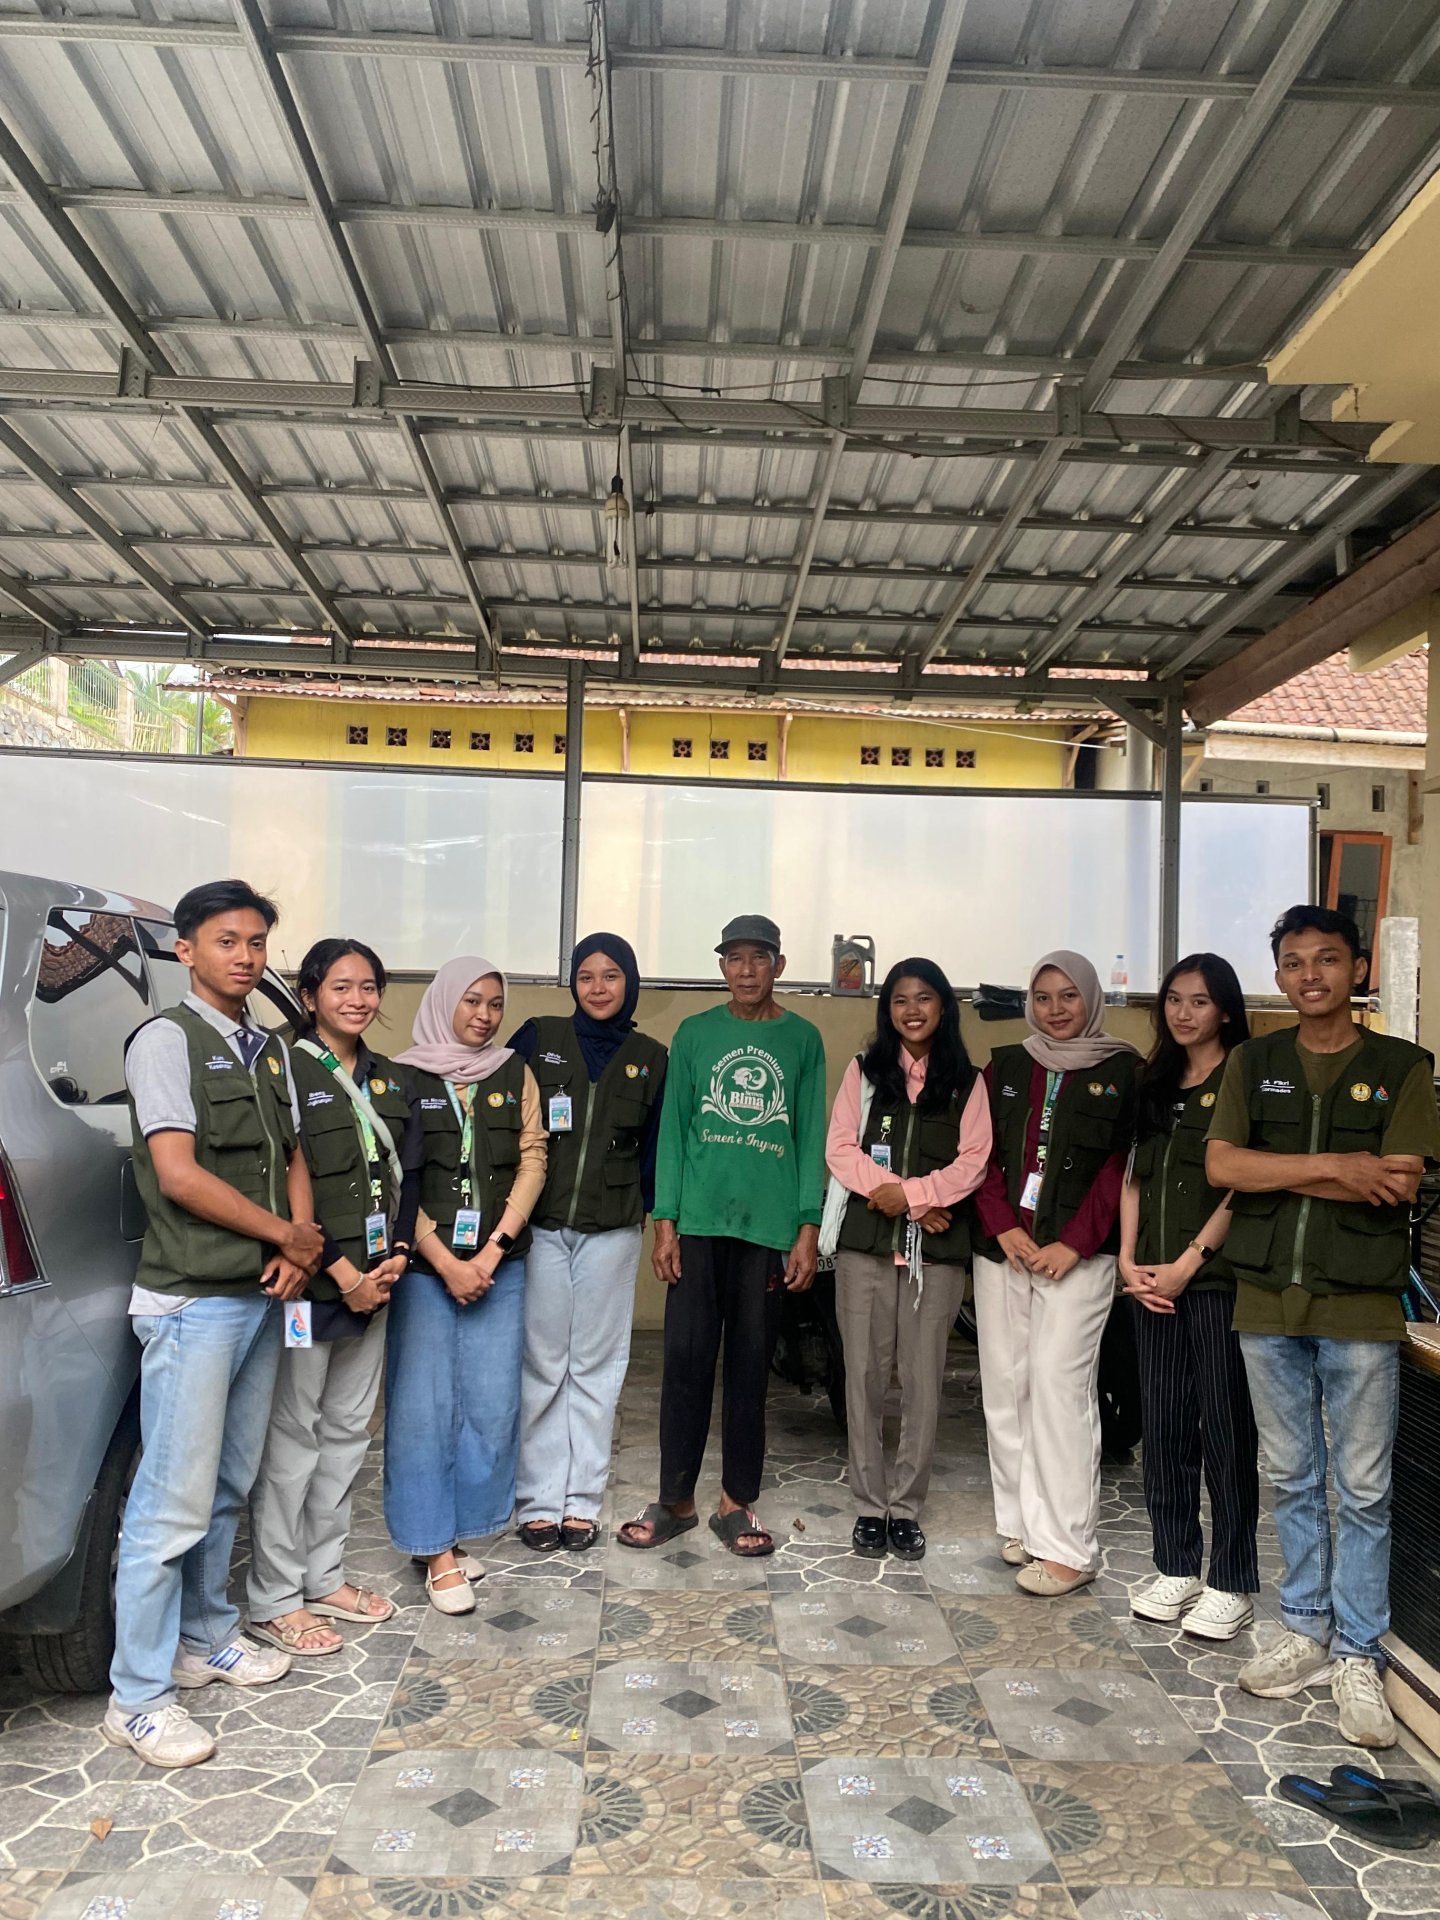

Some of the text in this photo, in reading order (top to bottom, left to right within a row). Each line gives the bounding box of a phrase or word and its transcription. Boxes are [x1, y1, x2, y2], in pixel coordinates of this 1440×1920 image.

[711, 1045, 785, 1080] Semen Premium
[730, 1091, 764, 1107] Bima
